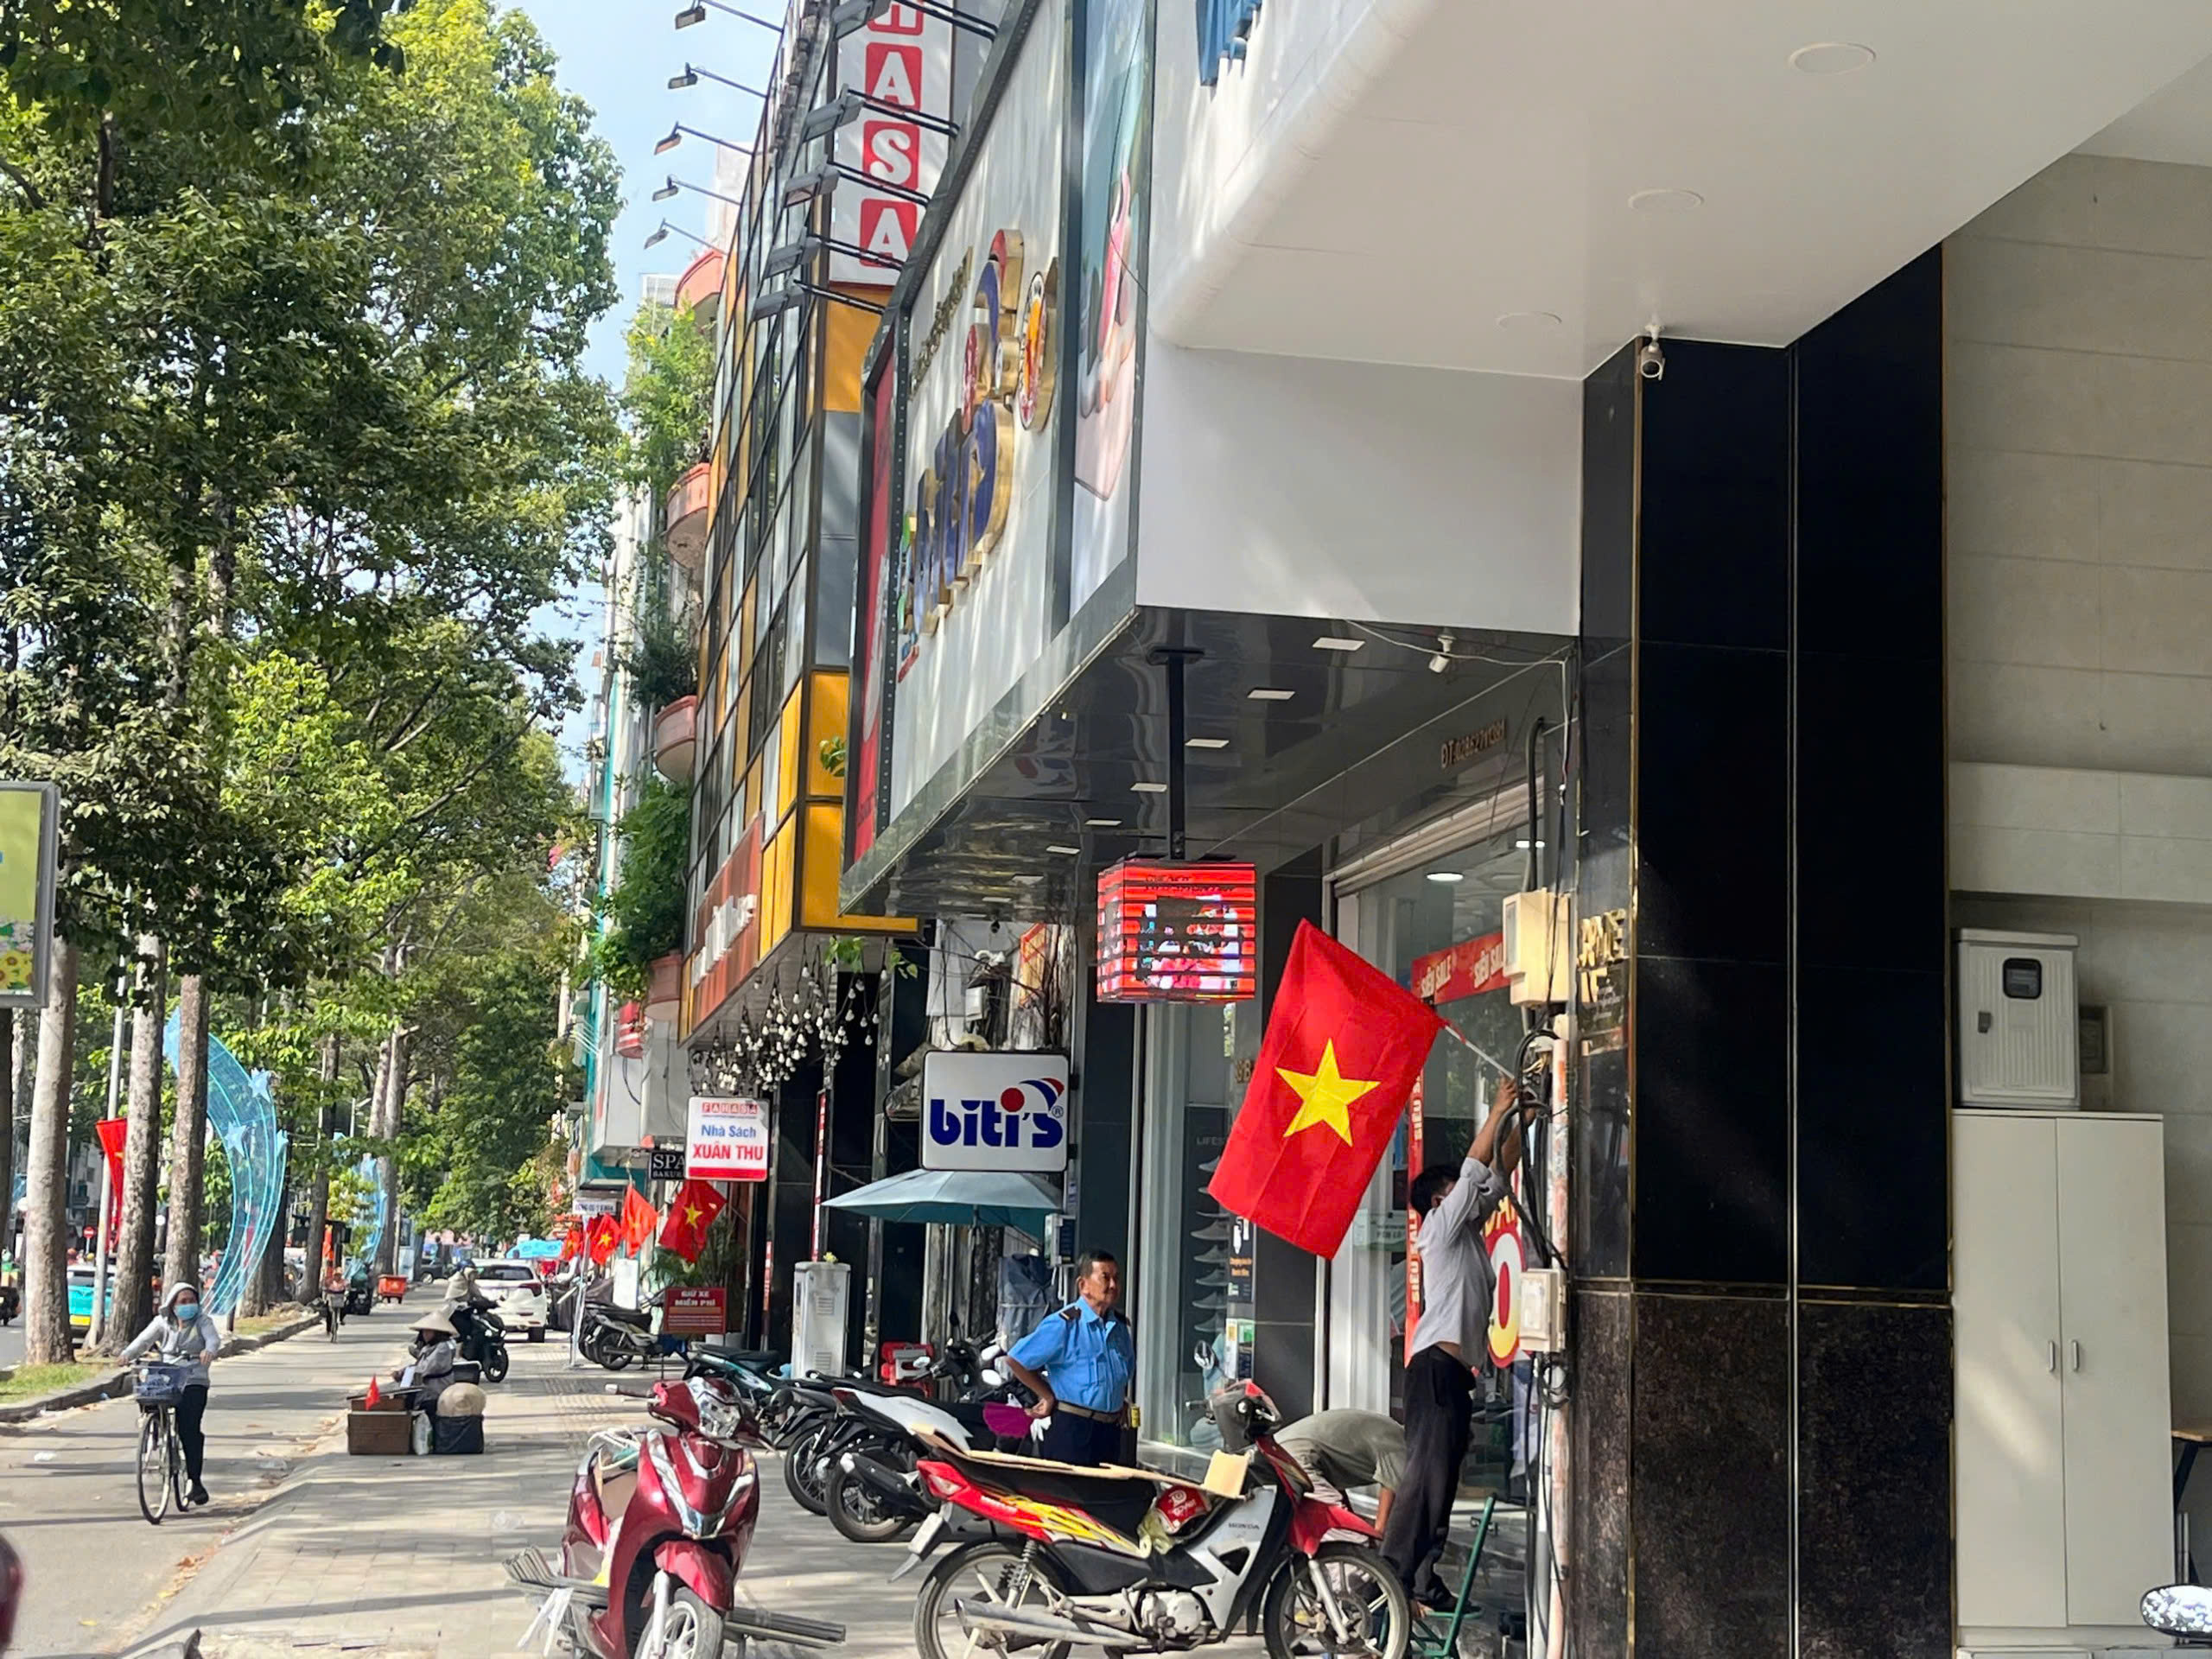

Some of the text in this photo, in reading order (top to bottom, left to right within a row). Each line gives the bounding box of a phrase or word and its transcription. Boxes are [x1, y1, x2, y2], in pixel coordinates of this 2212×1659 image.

[930, 1087, 1064, 1148] biti's
[701, 1125, 756, 1138] Nhà Sách
[693, 1141, 763, 1160] XUÂN THU
